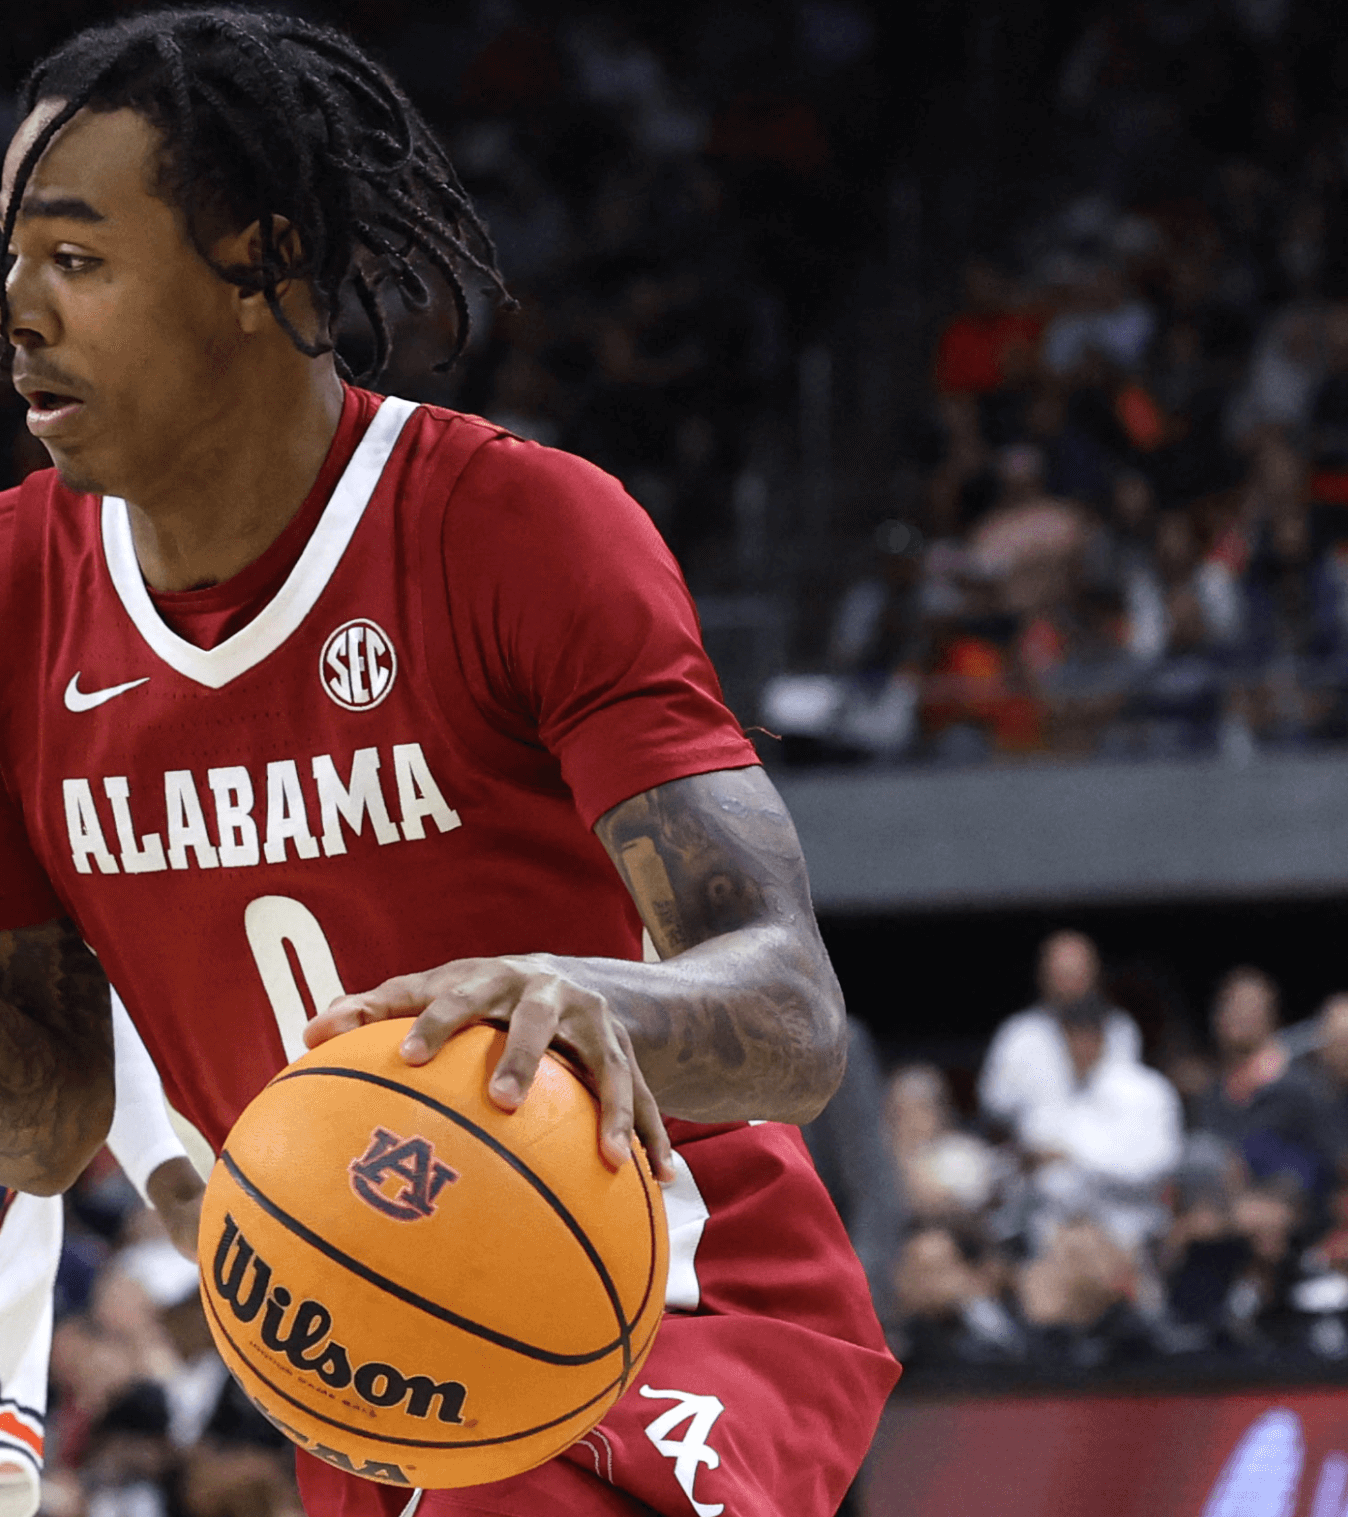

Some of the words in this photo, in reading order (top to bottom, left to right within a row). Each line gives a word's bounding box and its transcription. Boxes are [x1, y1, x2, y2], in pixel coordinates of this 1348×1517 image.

[328, 626, 391, 704] SEC
[62, 742, 462, 875] ALABAMA
[213, 1211, 468, 1424] Wilson
